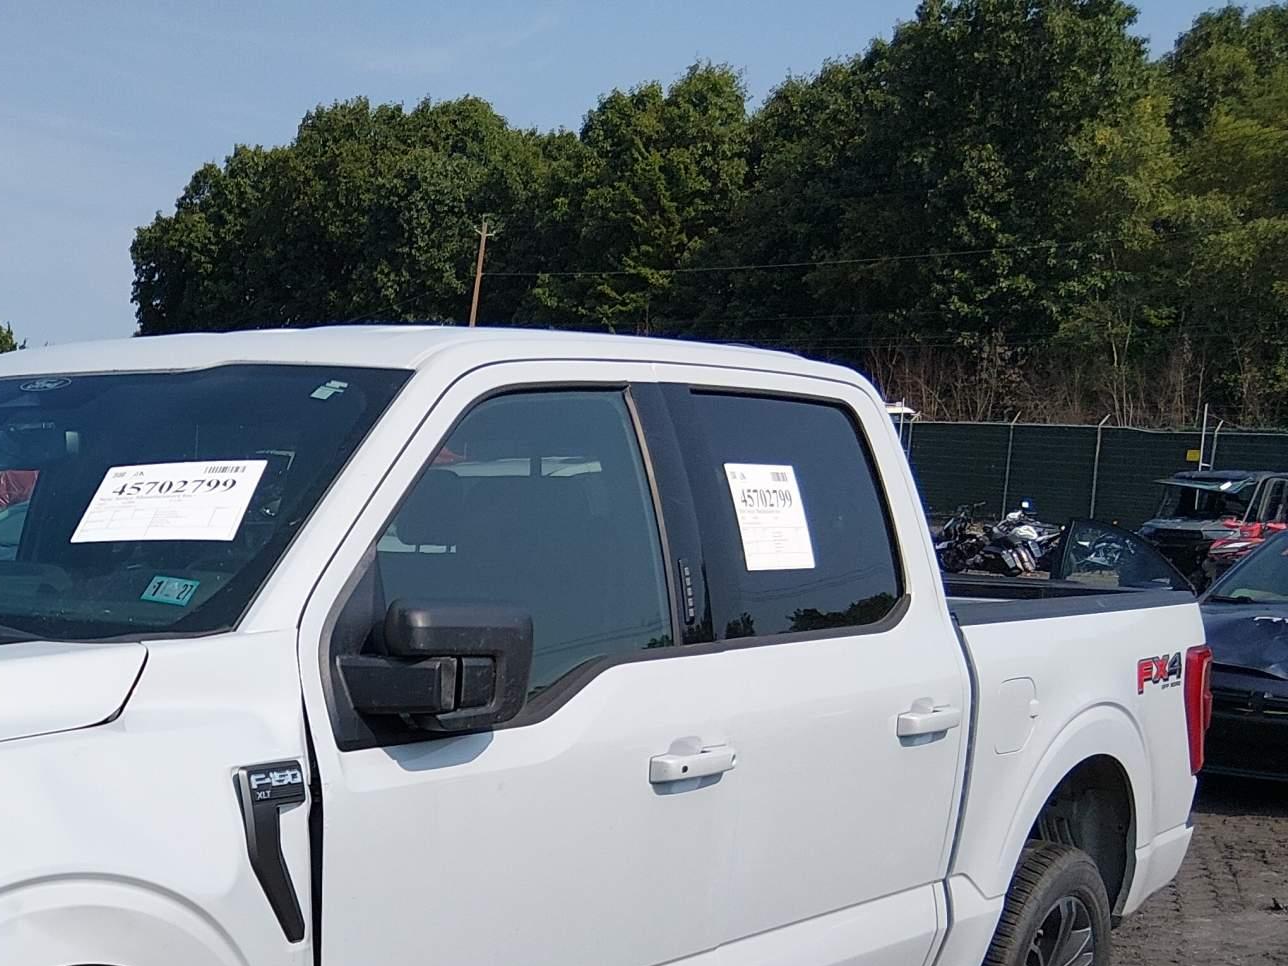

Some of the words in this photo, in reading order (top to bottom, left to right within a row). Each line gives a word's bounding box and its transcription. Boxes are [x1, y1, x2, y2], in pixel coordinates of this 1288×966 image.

[112, 479, 237, 496] 45702799
[740, 488, 793, 509] 45702799
[176, 583, 194, 600] 27
[1138, 652, 1182, 695] FX4
[250, 768, 302, 789] F-150
[256, 790, 271, 800] XLT
